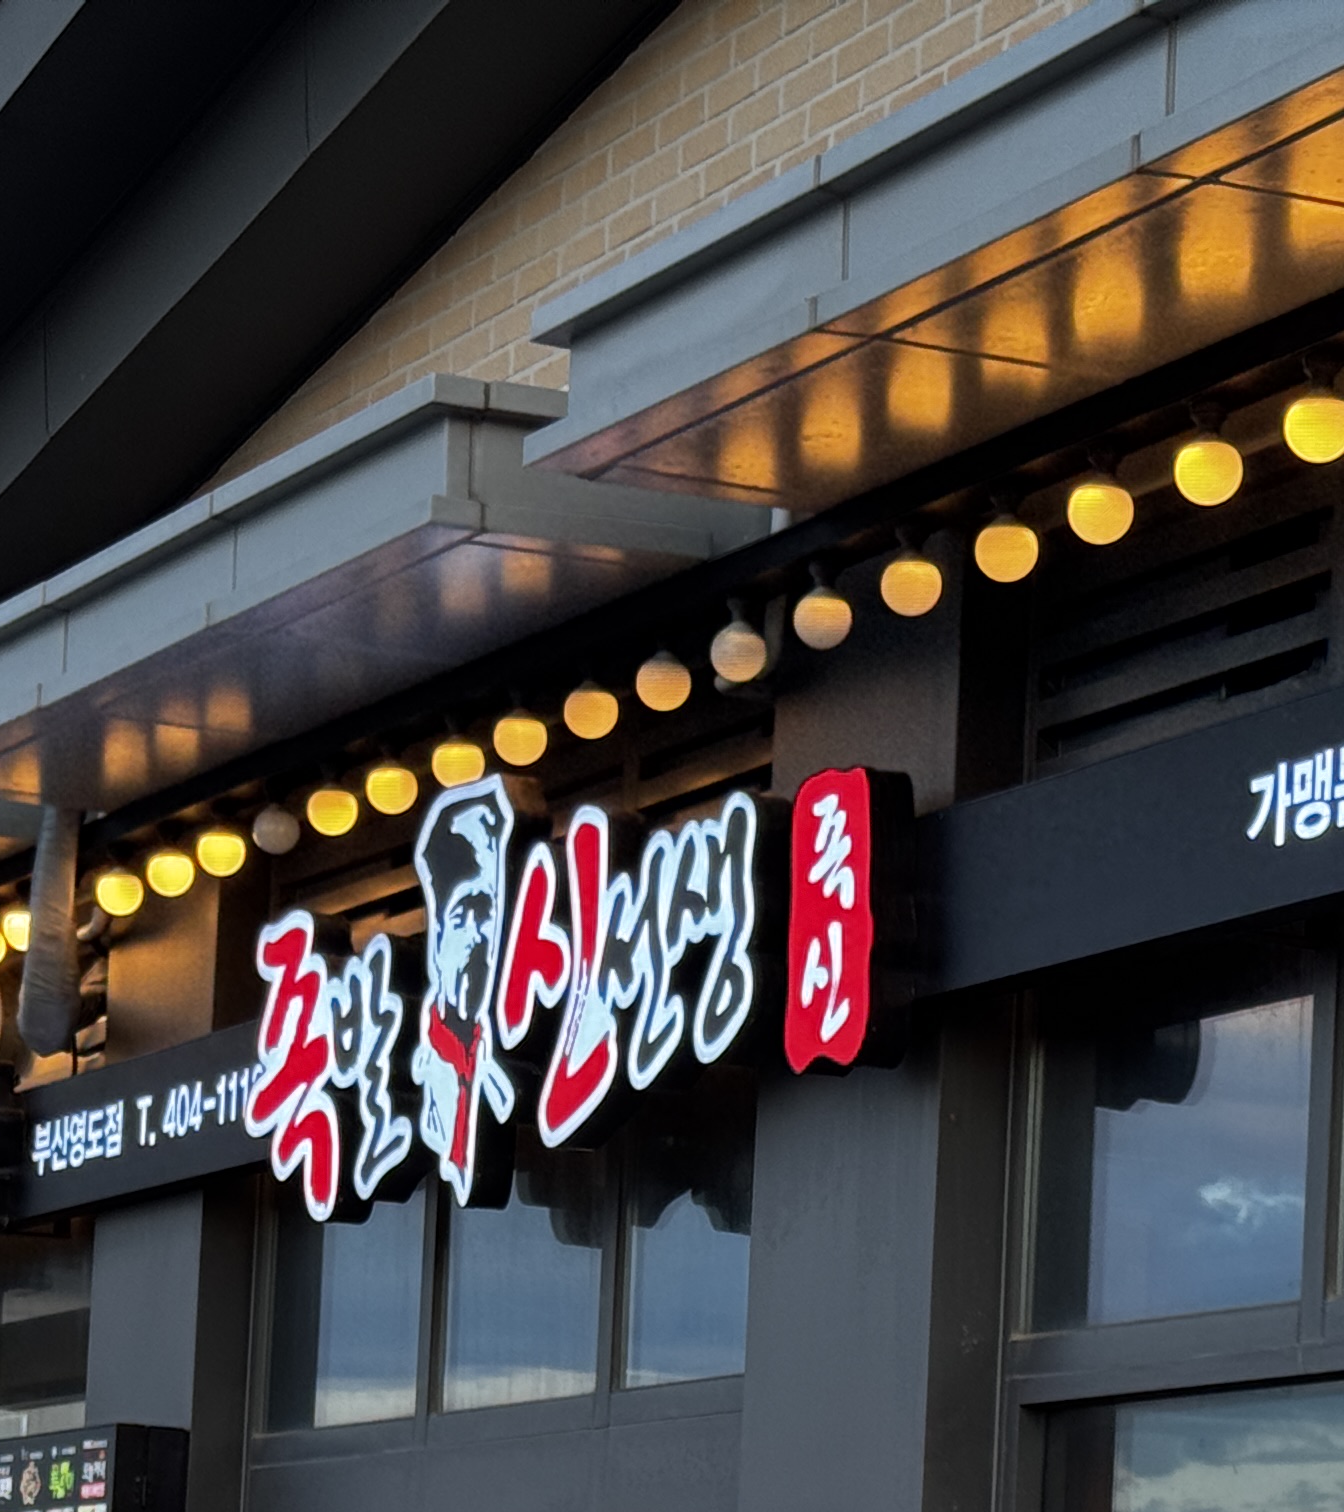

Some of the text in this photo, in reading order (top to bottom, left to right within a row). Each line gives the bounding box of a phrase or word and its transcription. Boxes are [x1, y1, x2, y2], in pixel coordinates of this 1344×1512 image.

[496, 789, 758, 1149] 신선생
[30, 1099, 125, 1177] 부산영도점
[137, 1095, 157, 1147] T.
